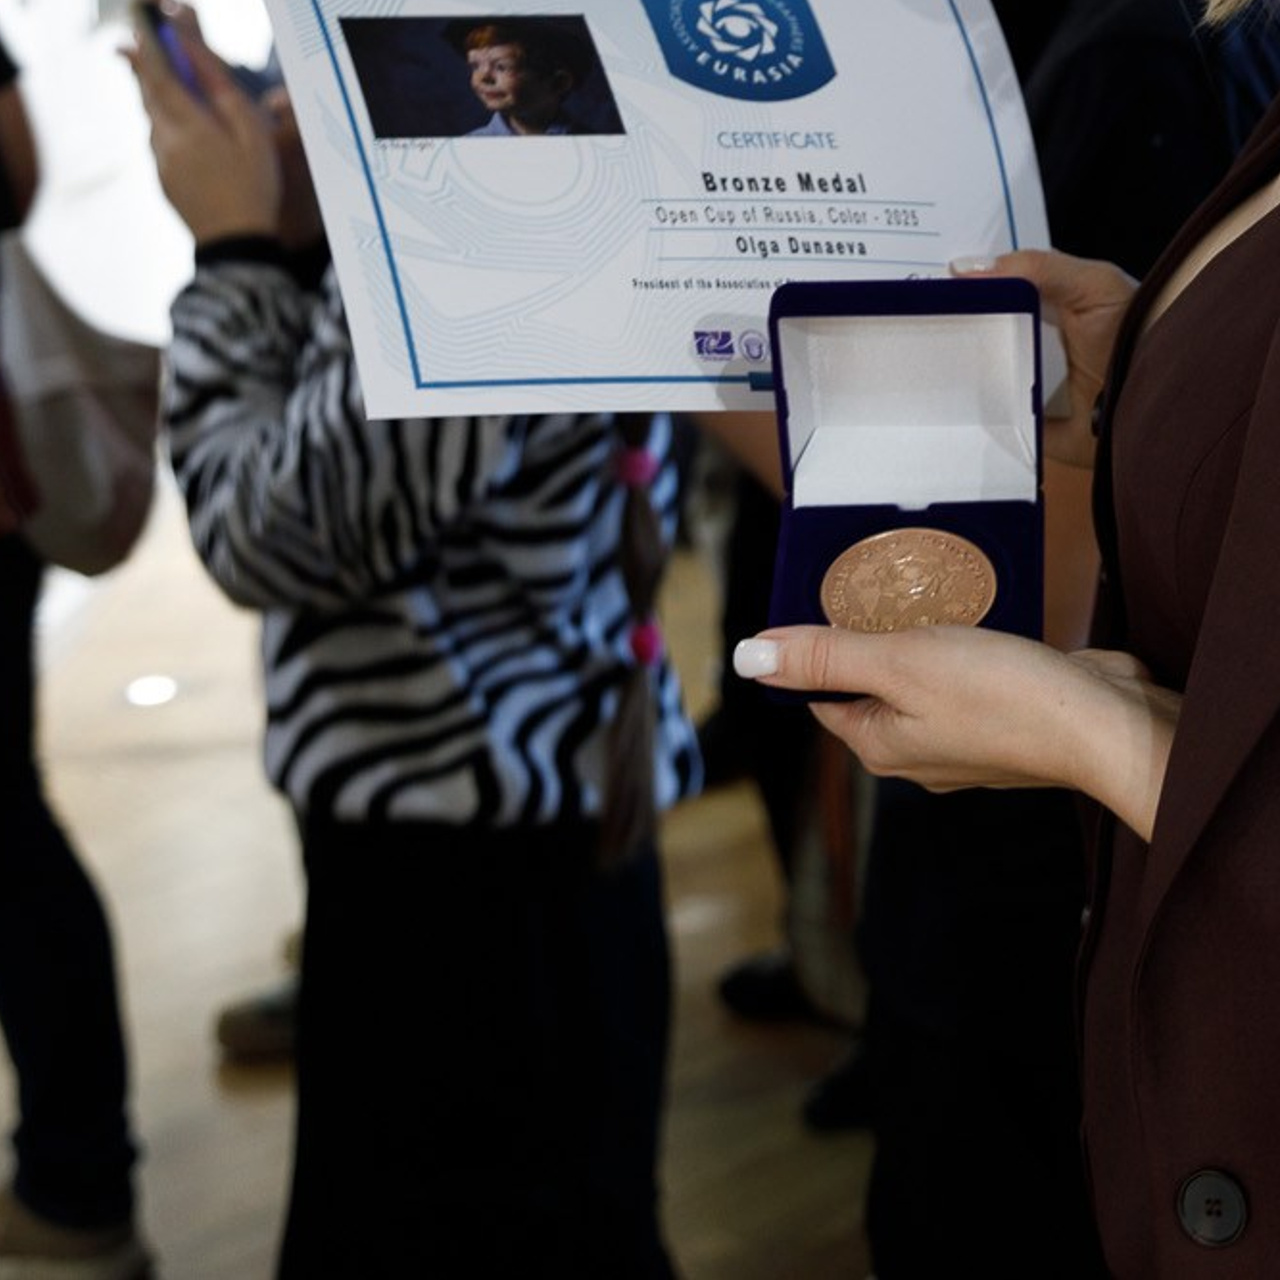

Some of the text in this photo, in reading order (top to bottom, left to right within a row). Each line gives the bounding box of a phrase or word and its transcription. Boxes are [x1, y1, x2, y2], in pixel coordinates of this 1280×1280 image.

[696, 53, 804, 84] EURASIA
[717, 131, 839, 150] CERTIFICATE
[702, 172, 867, 194] Bronze Medal
[655, 207, 698, 226] Open
[704, 207, 736, 226] Cup
[742, 207, 758, 223] of
[763, 207, 823, 226] Russia,
[828, 208, 868, 225] Color
[885, 209, 920, 227] 2025
[735, 236, 868, 258] Olga Dunaeva
[632, 278, 680, 290] President
[684, 278, 694, 289] of
[697, 278, 713, 289] the
[716, 278, 771, 289] Association
